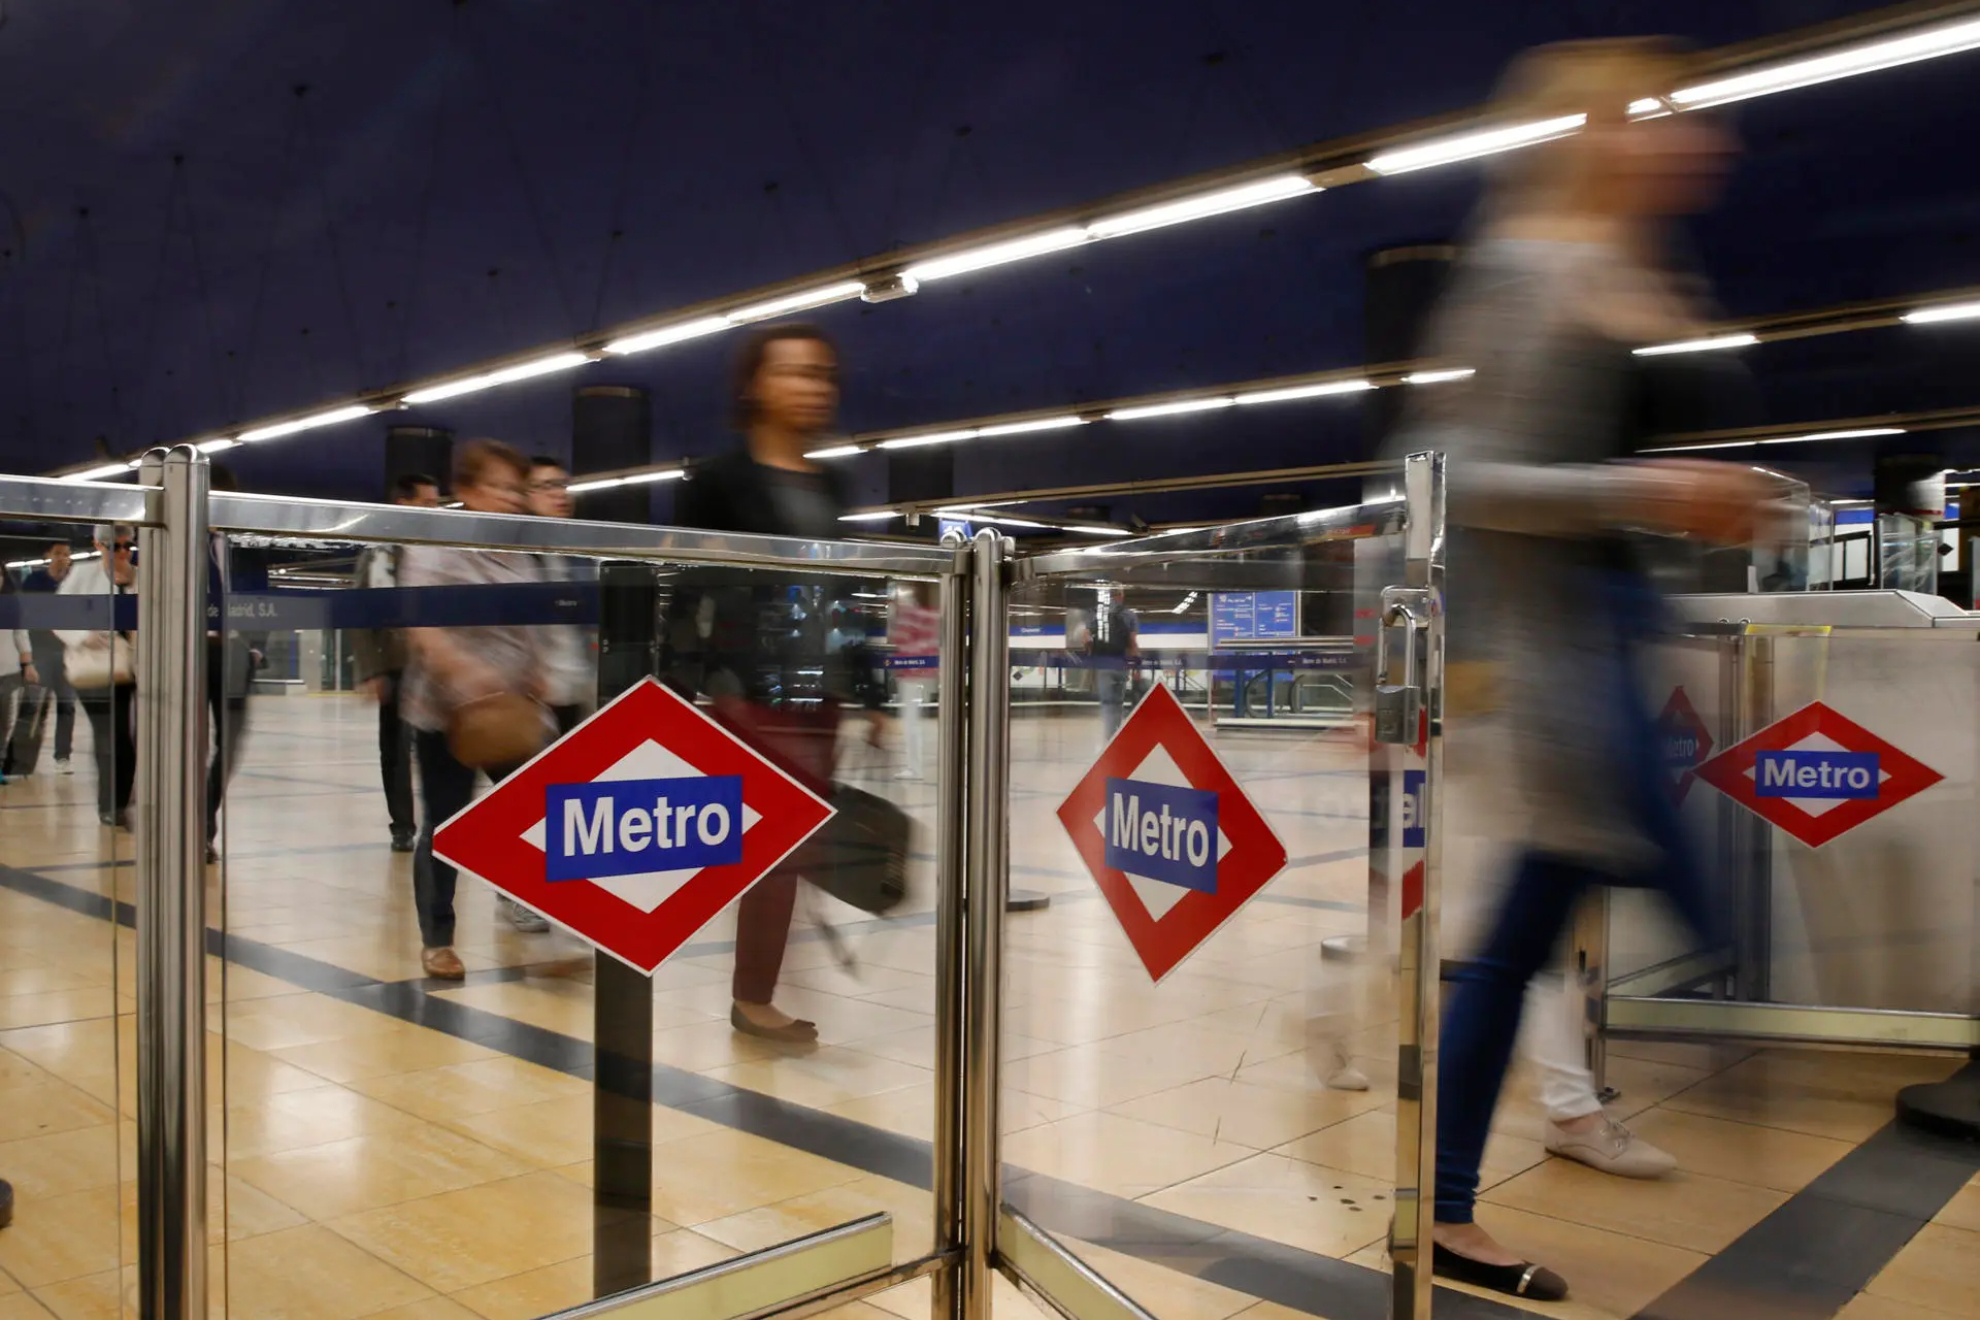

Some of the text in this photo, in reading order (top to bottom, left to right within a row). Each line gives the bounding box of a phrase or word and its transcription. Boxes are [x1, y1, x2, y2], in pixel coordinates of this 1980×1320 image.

[1763, 758, 1870, 789] Metro
[563, 796, 731, 857] Metro
[1112, 792, 1209, 867] Metro
